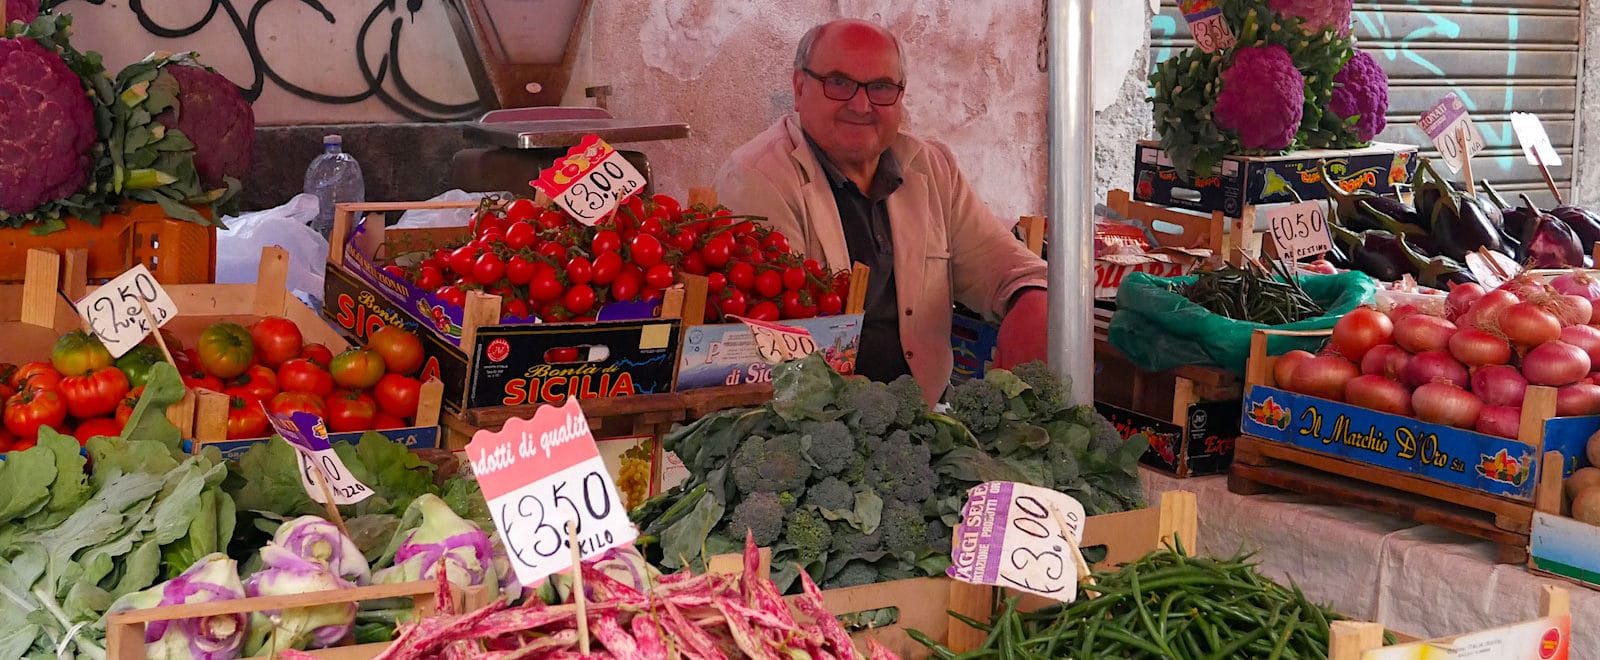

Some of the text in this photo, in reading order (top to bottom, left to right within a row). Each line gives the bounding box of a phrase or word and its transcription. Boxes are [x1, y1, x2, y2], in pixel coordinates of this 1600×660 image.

[564, 161, 624, 219] €3.00
[1272, 209, 1321, 250] €0.50
[503, 371, 635, 406] SICILIA
[726, 369, 741, 386] di
[519, 431, 537, 459] di
[1322, 414, 1390, 454] Marchio
[1394, 427, 1449, 468] D'Oro
[502, 471, 611, 568] €3.50
[579, 529, 614, 557] KILO
[999, 496, 1064, 594] €3.00
